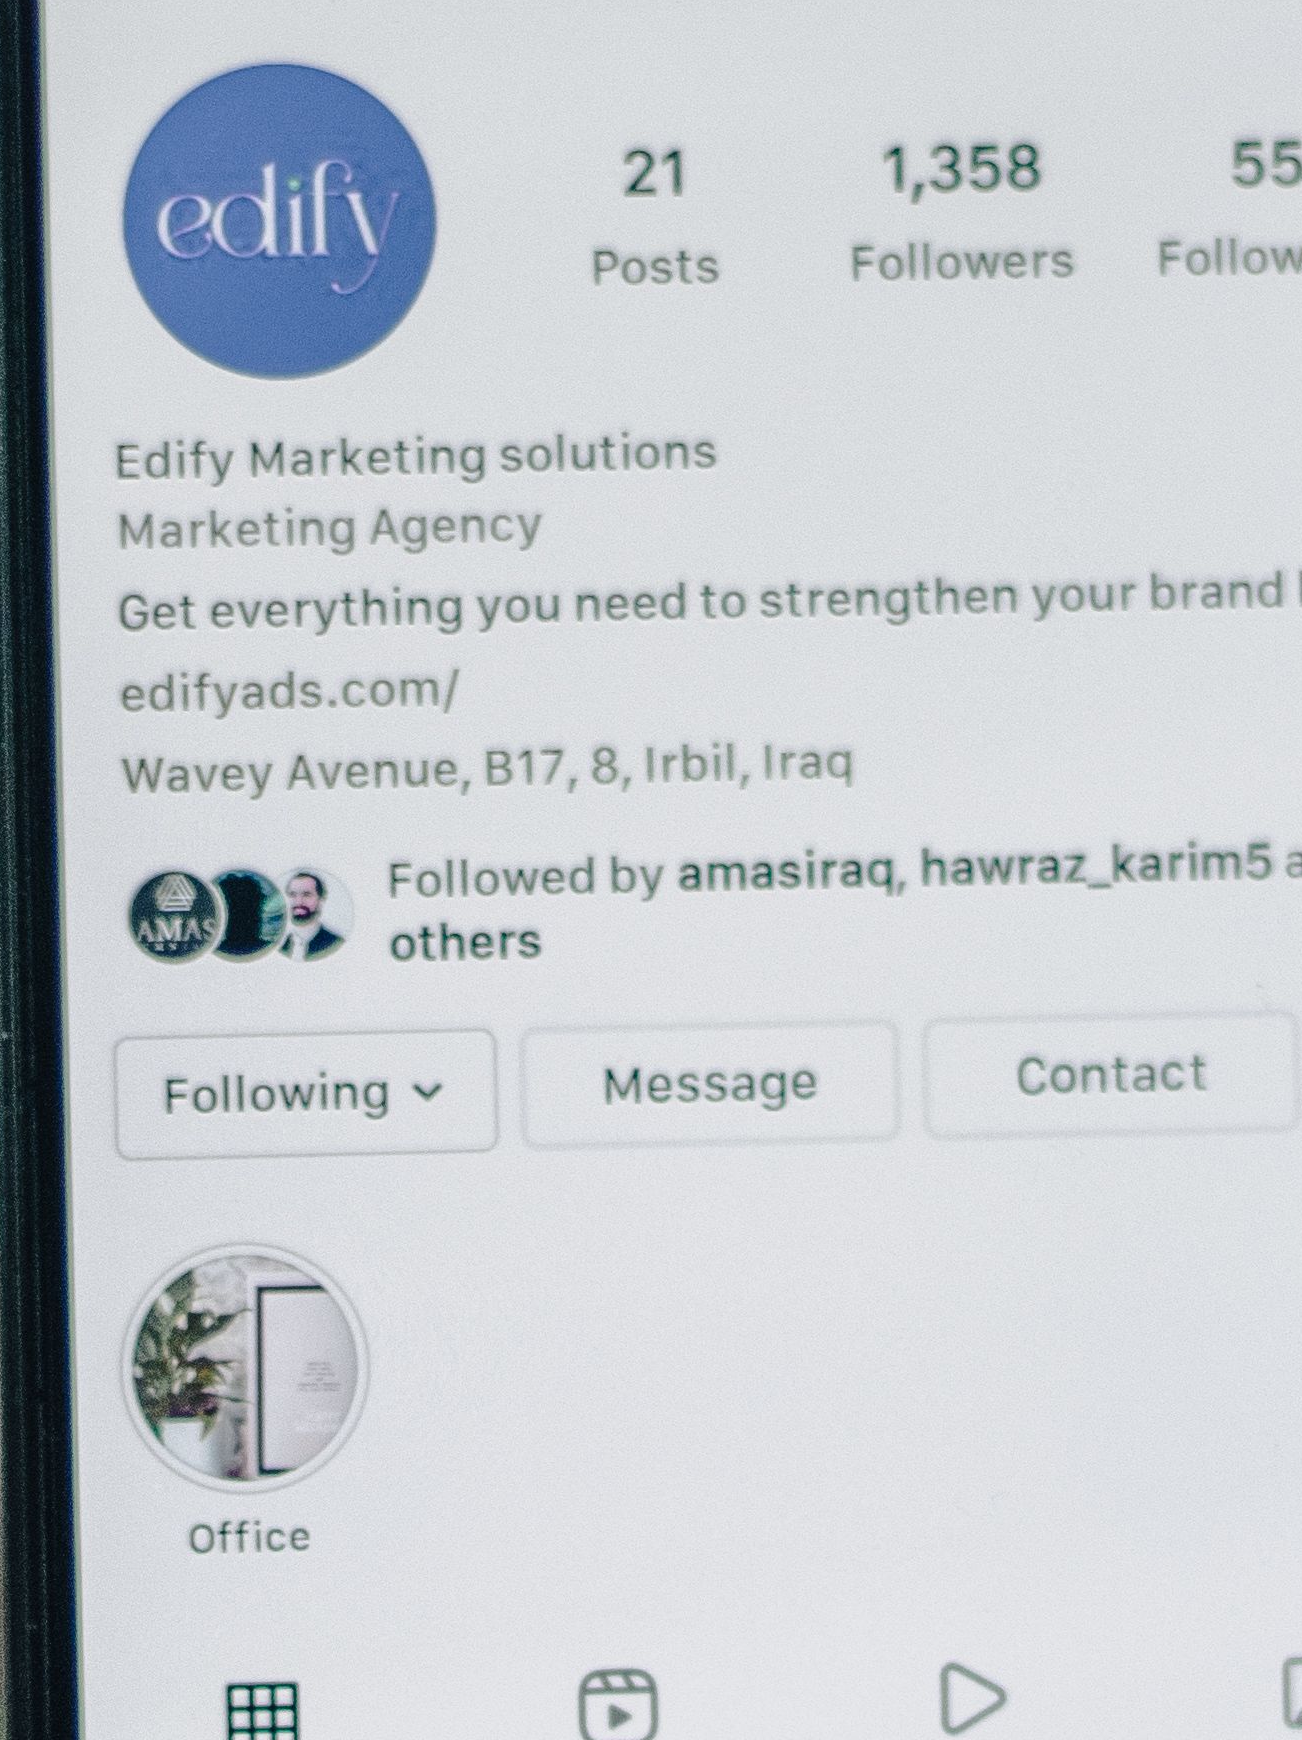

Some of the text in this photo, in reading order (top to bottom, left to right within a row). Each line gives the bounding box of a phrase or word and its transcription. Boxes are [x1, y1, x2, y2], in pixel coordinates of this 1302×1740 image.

[624, 147, 683, 196] 21
[884, 142, 1041, 203] 1,358
[158, 160, 399, 295] edify
[592, 247, 720, 285] Posts
[851, 241, 1075, 281] Followers
[115, 430, 717, 487] Edify Marketing solutions
[118, 506, 543, 556] Marketing Agency
[118, 592, 195, 632] Get
[209, 585, 463, 636] everything
[476, 594, 561, 633] you
[575, 581, 687, 621] need
[699, 584, 747, 619] to
[760, 576, 1018, 626] strengthen
[1031, 582, 1137, 622] your
[1150, 569, 1284, 610] brand
[119, 668, 460, 720] edifyads.com/
[120, 741, 853, 801] Wavey Avenue, B17, 8, Irbil, Iraq
[388, 855, 595, 898] Followed
[610, 854, 665, 902] by
[678, 849, 906, 895] amasiraq,
[921, 840, 1273, 889] hawraz_karim5
[389, 921, 542, 961] others
[164, 1071, 389, 1120] Following
[604, 1066, 817, 1112] Message
[1017, 1054, 1206, 1096] Contact
[188, 1519, 310, 1555] Office
